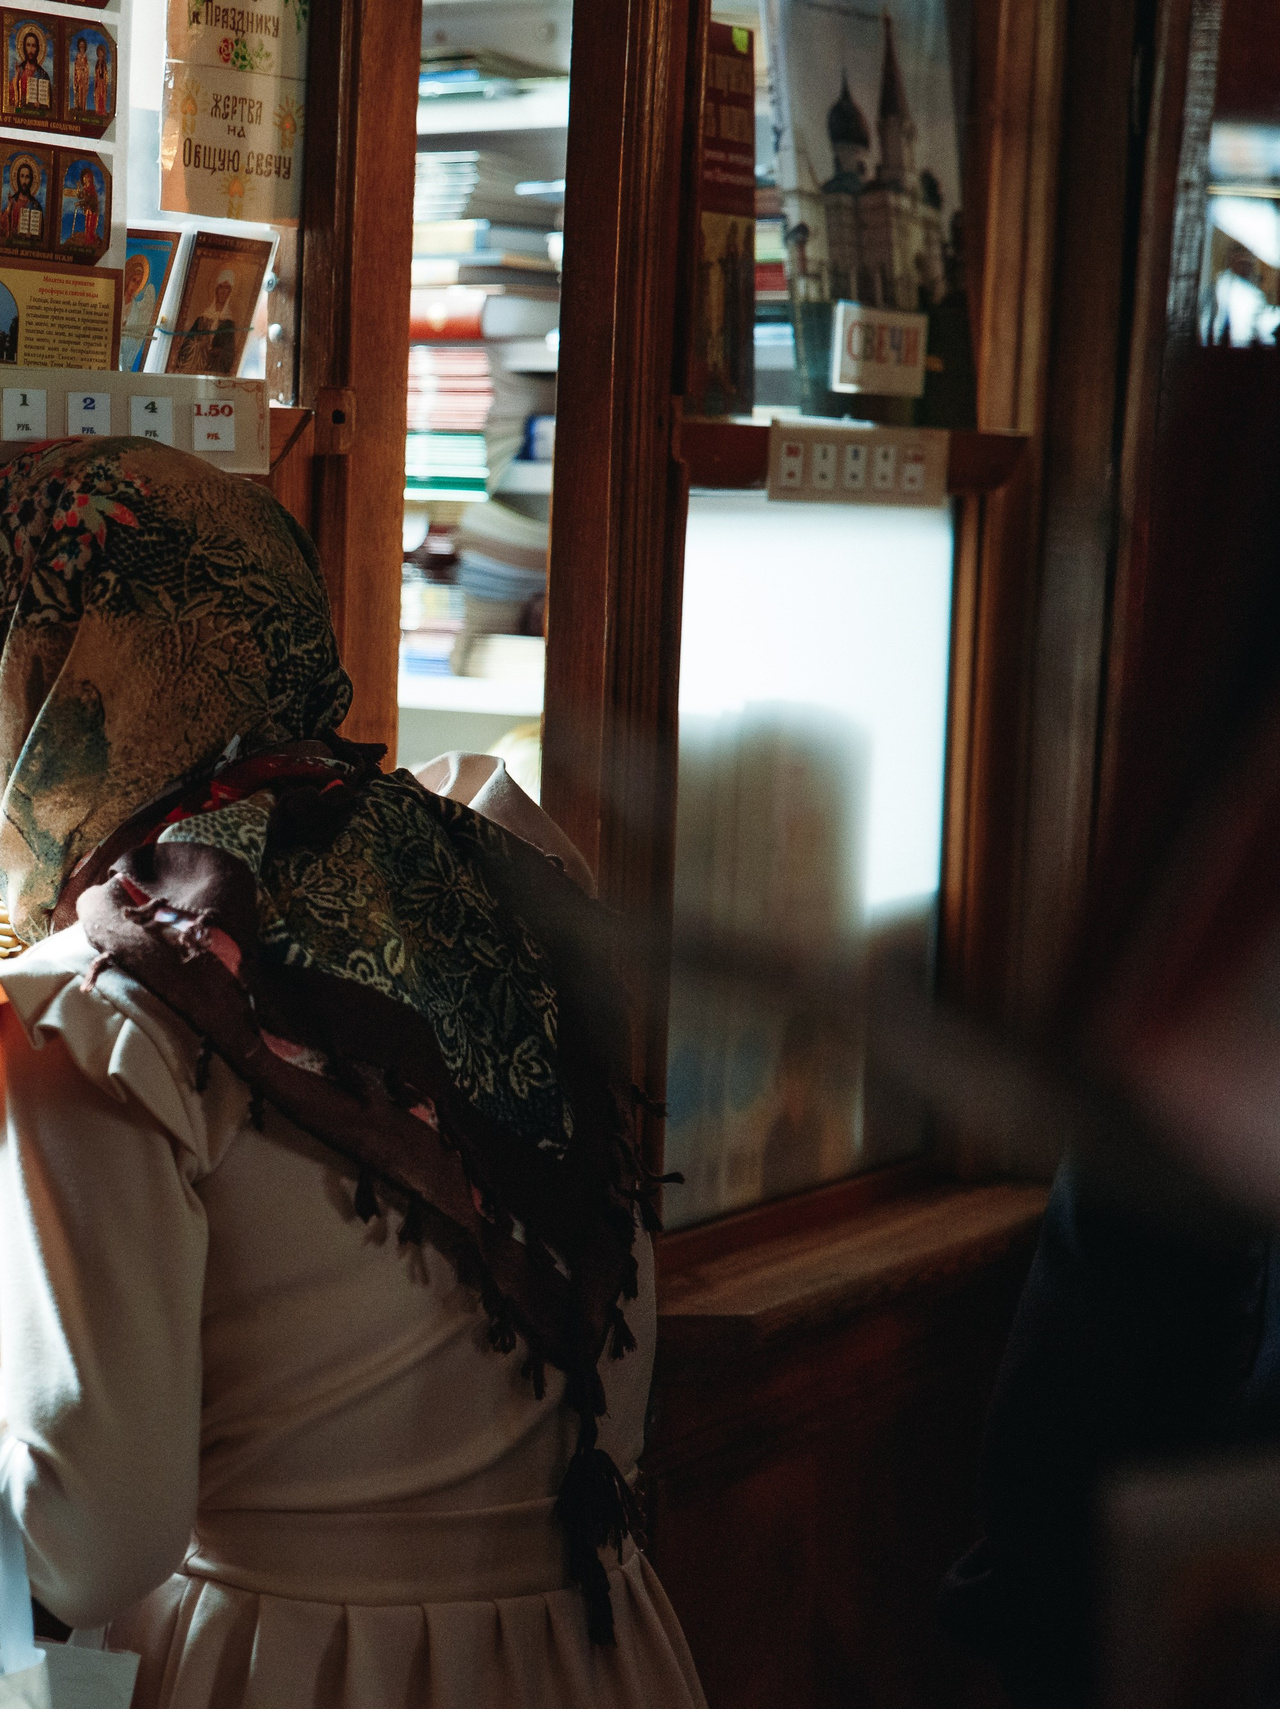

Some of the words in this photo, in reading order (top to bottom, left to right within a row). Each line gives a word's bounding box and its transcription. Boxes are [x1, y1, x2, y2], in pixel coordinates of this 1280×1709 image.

[20, 394, 30, 407] 1
[82, 397, 96, 410] 2
[144, 401, 158, 413] 4
[194, 404, 233, 418] 1.50
[16, 423, 32, 432] РУБ.
[206, 432, 221, 440] РУБ.
